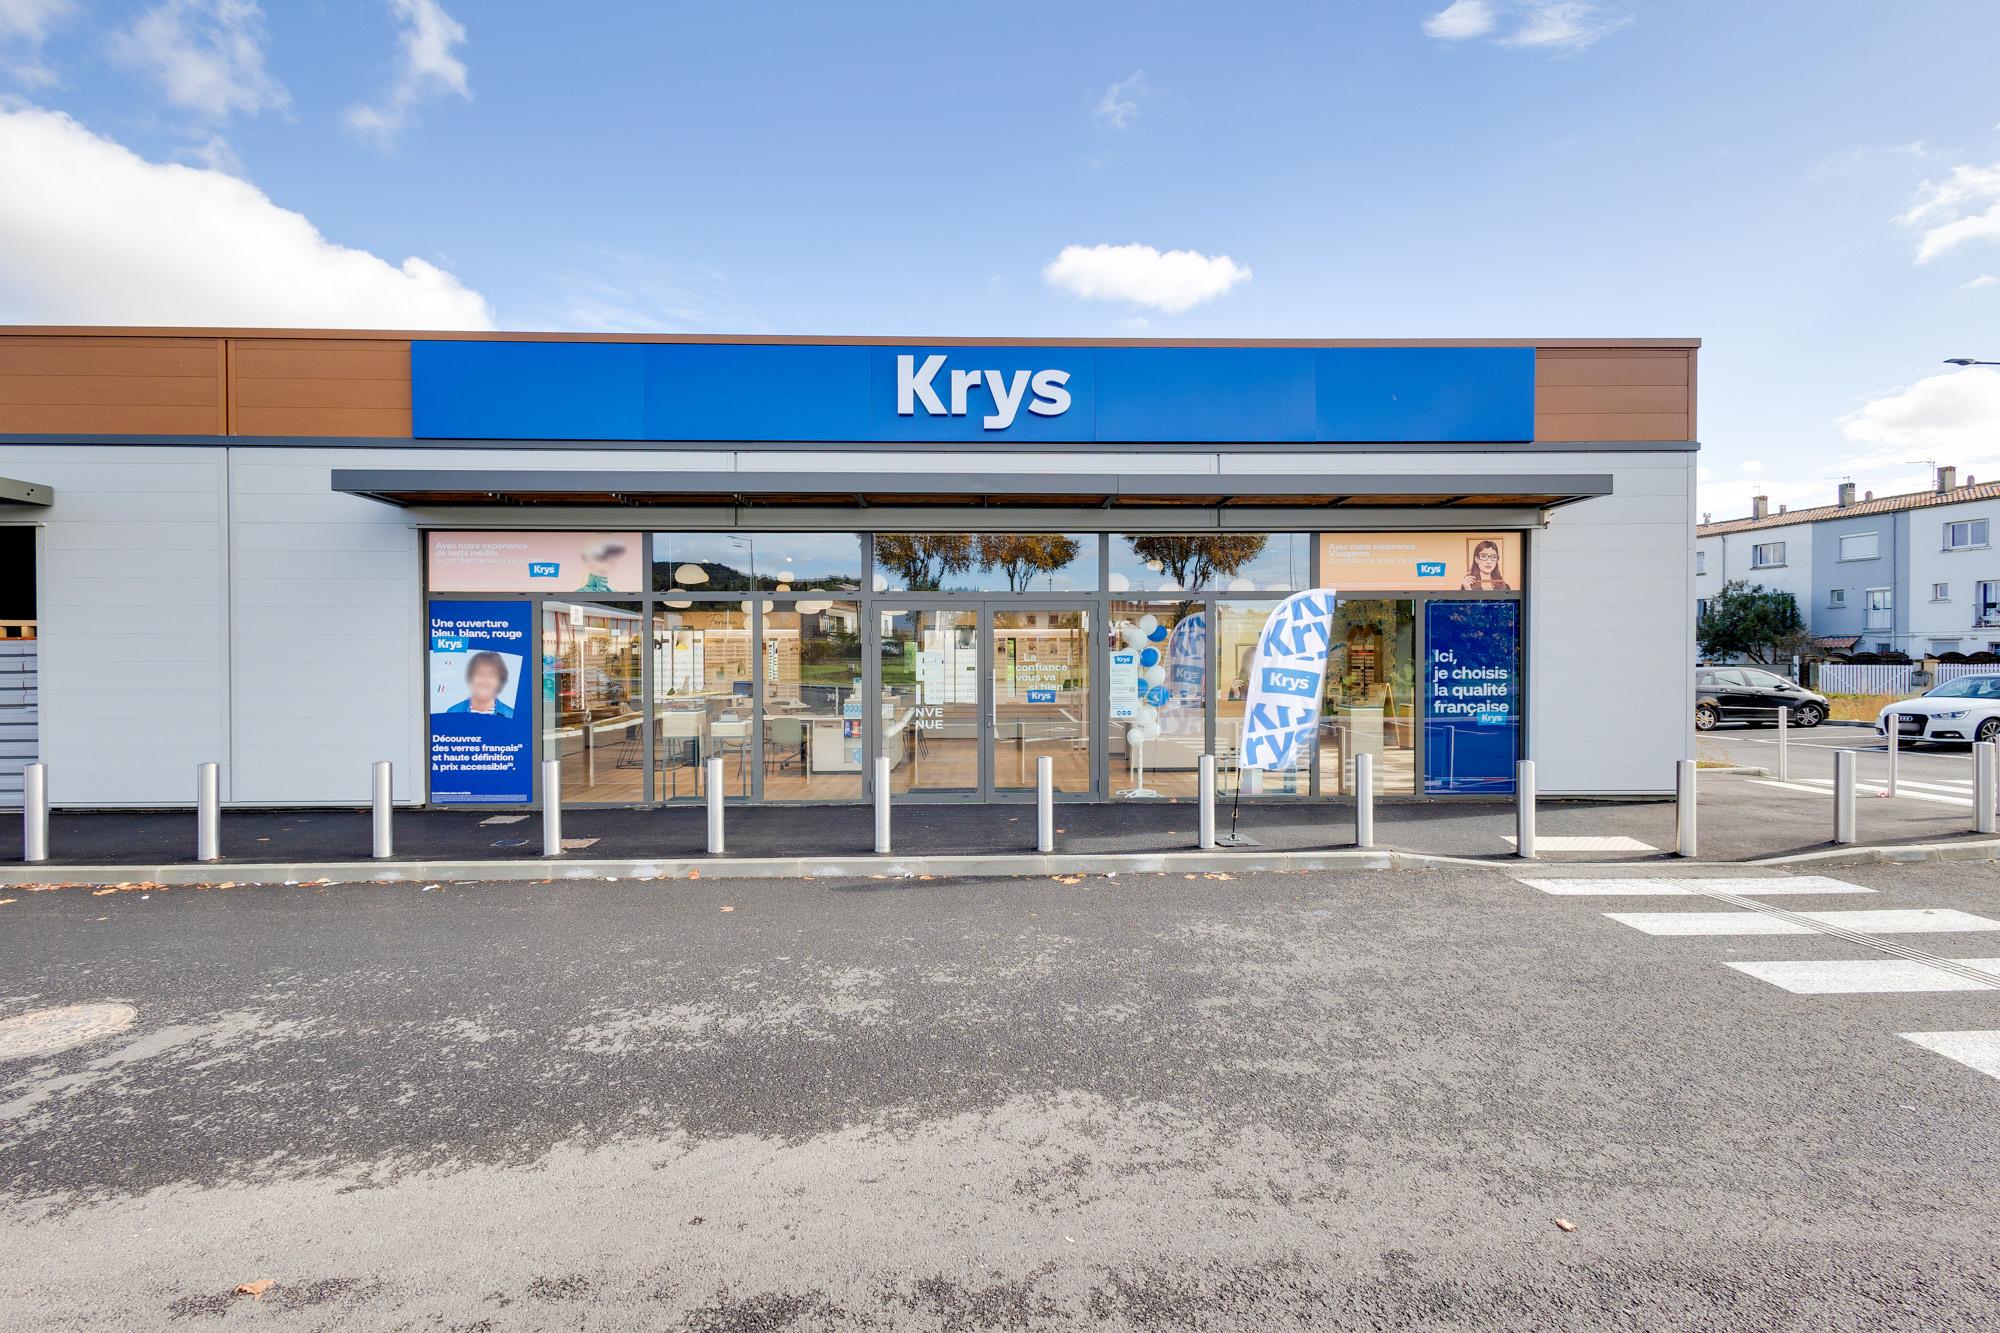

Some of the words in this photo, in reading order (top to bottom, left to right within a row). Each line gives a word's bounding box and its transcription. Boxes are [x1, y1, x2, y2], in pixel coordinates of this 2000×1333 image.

[897, 355, 1072, 430] Krys
[534, 565, 555, 575] Krys
[1421, 565, 1441, 575] Krys
[432, 618, 454, 628] Une
[456, 619, 509, 628] ouverture
[459, 628, 490, 639] blanc,
[492, 630, 523, 640] rouge
[438, 639, 462, 650] Krys
[1434, 649, 1457, 665] Ici,
[1433, 666, 1448, 683] je
[1452, 666, 1508, 680] choisis
[1270, 672, 1309, 691] Krys
[1434, 683, 1448, 697] la
[1452, 683, 1508, 699] qualité
[1031, 692, 1052, 701] Krys
[915, 708, 944, 717] NVE
[1434, 700, 1509, 717] française
[1481, 713, 1503, 723] Krys
[915, 720, 944, 729] NUE
[432, 744, 449, 752] des
[451, 744, 480, 752] verres
[444, 753, 470, 761] haute
[471, 753, 514, 761] définition
[440, 763, 458, 772] prix
